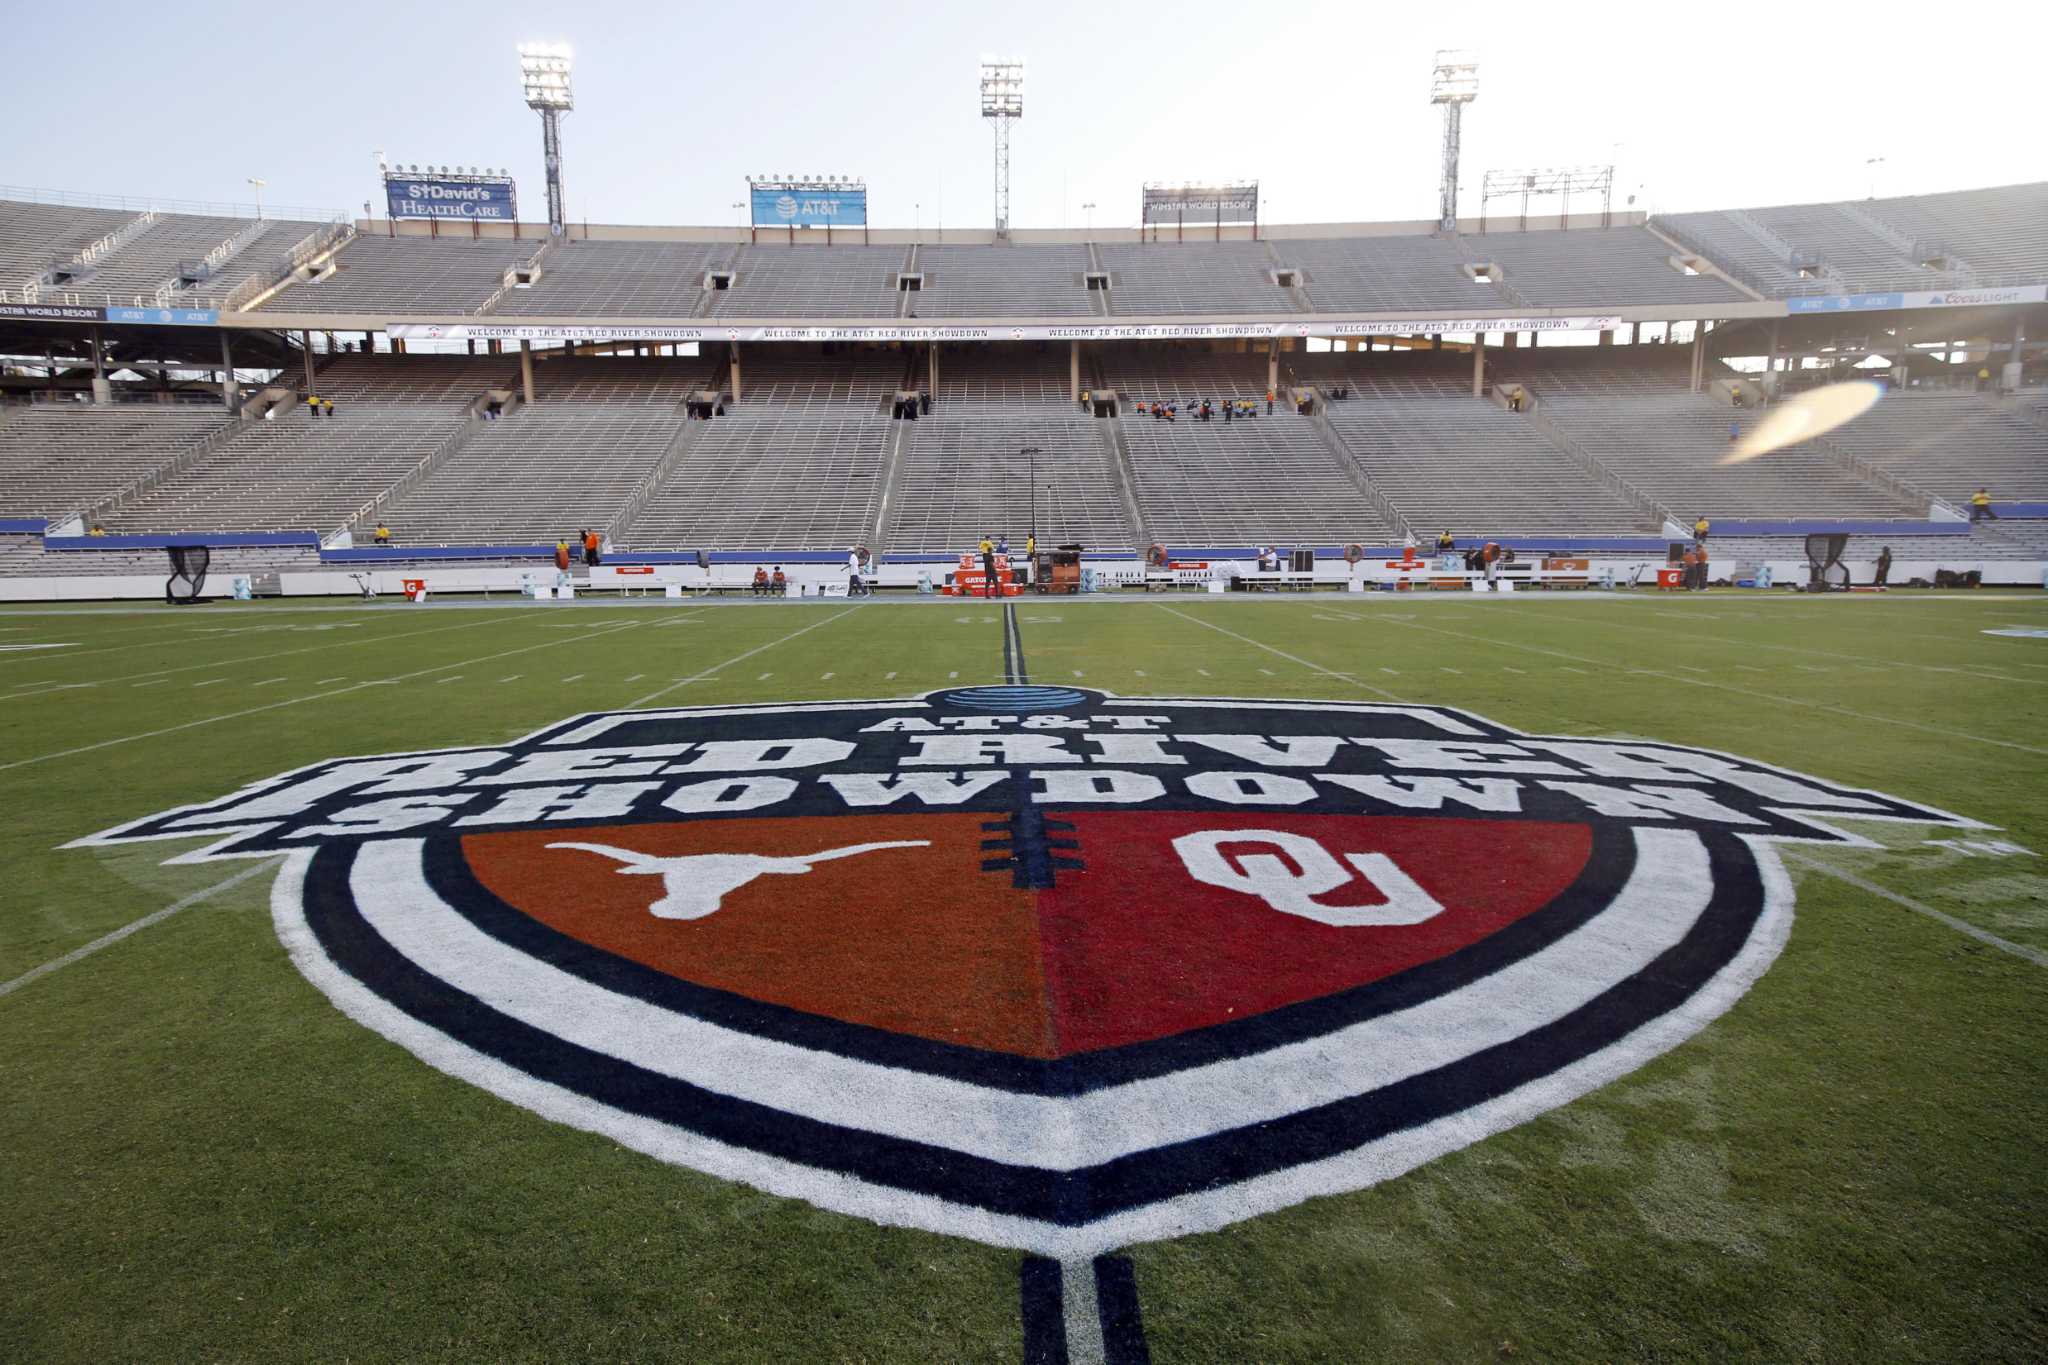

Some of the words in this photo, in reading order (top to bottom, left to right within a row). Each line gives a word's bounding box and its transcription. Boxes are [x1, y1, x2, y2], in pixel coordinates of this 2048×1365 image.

[801, 200, 840, 215] AT&T
[1188, 201, 1218, 210] WORLD
[1220, 200, 1252, 209] RESORT
[0, 306, 26, 316] STAR
[26, 307, 61, 316] WORLD
[62, 308, 98, 318] RESORT
[122, 311, 145, 320] AT&T
[187, 312, 209, 321] AT&T
[1048, 328, 1095, 337] WELCOME
[1099, 328, 1110, 336] TO
[1114, 328, 1133, 336] THE
[1183, 327, 1212, 335] RIVER
[1216, 326, 1273, 335] SHOWDOWN
[1335, 324, 1384, 333] WELCOME
[1387, 324, 1399, 332] TO
[1402, 323, 1420, 332] THE
[1475, 322, 1505, 330] RIVER
[1509, 320, 1570, 329] SHOWDOWN
[467, 328, 517, 336] WELCOME
[520, 328, 534, 337] TO
[537, 329, 557, 337] THE
[611, 329, 640, 337] RIVER
[644, 329, 702, 337] SHOWDOWN
[764, 330, 810, 338] WELCOME
[815, 330, 827, 338] TO
[831, 330, 848, 338] THE
[900, 330, 928, 338] RIVER
[930, 329, 988, 337] SHOWDOWN
[1667, 573, 1678, 583] G
[406, 582, 417, 593] G
[858, 715, 1172, 733] AT&T
[160, 737, 858, 829] RED
[898, 733, 1895, 811] RIVER
[278, 770, 1772, 839] SHOWDOWN
[1170, 829, 1447, 927] OU
